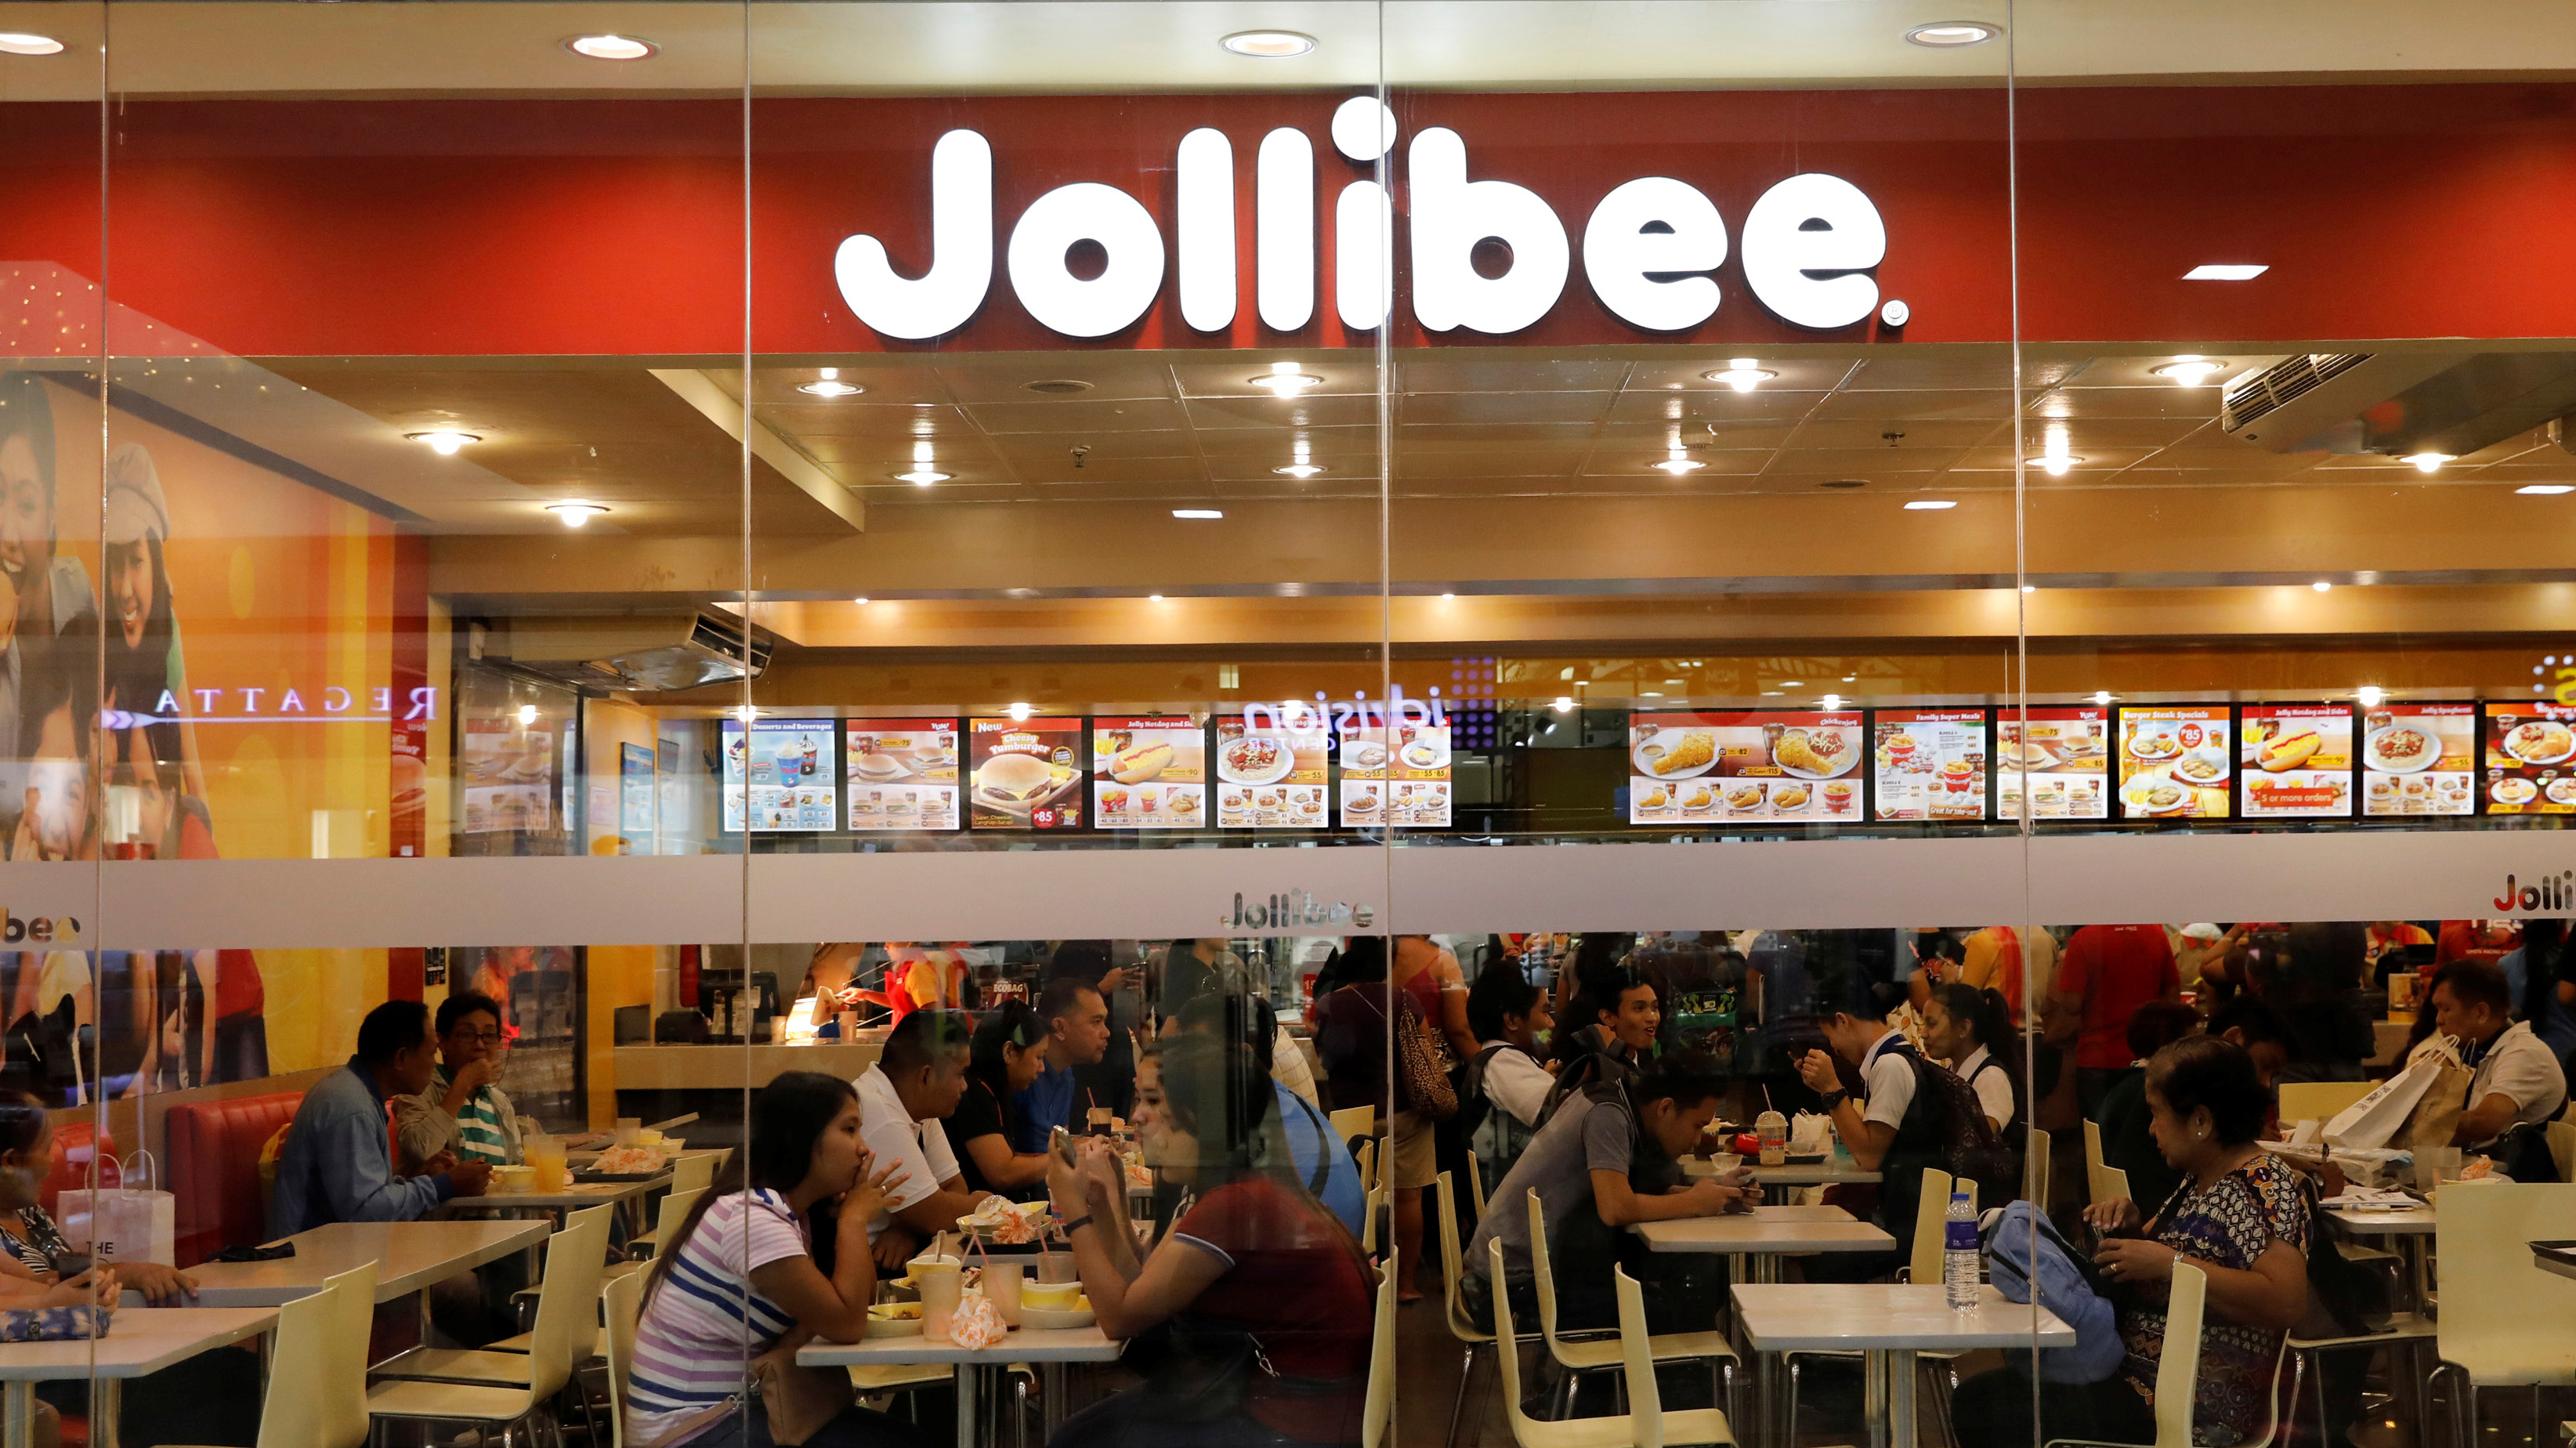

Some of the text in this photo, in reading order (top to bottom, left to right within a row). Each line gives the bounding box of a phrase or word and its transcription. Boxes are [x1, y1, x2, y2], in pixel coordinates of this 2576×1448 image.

[835, 96, 1887, 339] Jollibee
[2123, 711, 2151, 720] Burger
[2176, 711, 2209, 720] Specials
[2275, 708, 2292, 717] Jolly
[2292, 708, 2317, 717] Hotdog
[2438, 706, 2473, 715] Spaghetti
[978, 722, 1002, 733] New
[1820, 718, 1858, 728] Chickenjoy
[1004, 733, 1037, 744] Cheesy
[989, 742, 1051, 755] Yumburger
[2262, 794, 2267, 802] 5
[2304, 793, 2332, 802] orders
[1930, 806, 1945, 815] Great
[1945, 807, 1954, 816] for
[1954, 808, 1978, 816] take-out
[1220, 887, 1374, 930] Jollibee
[993, 983, 1024, 993] ECOBAG
